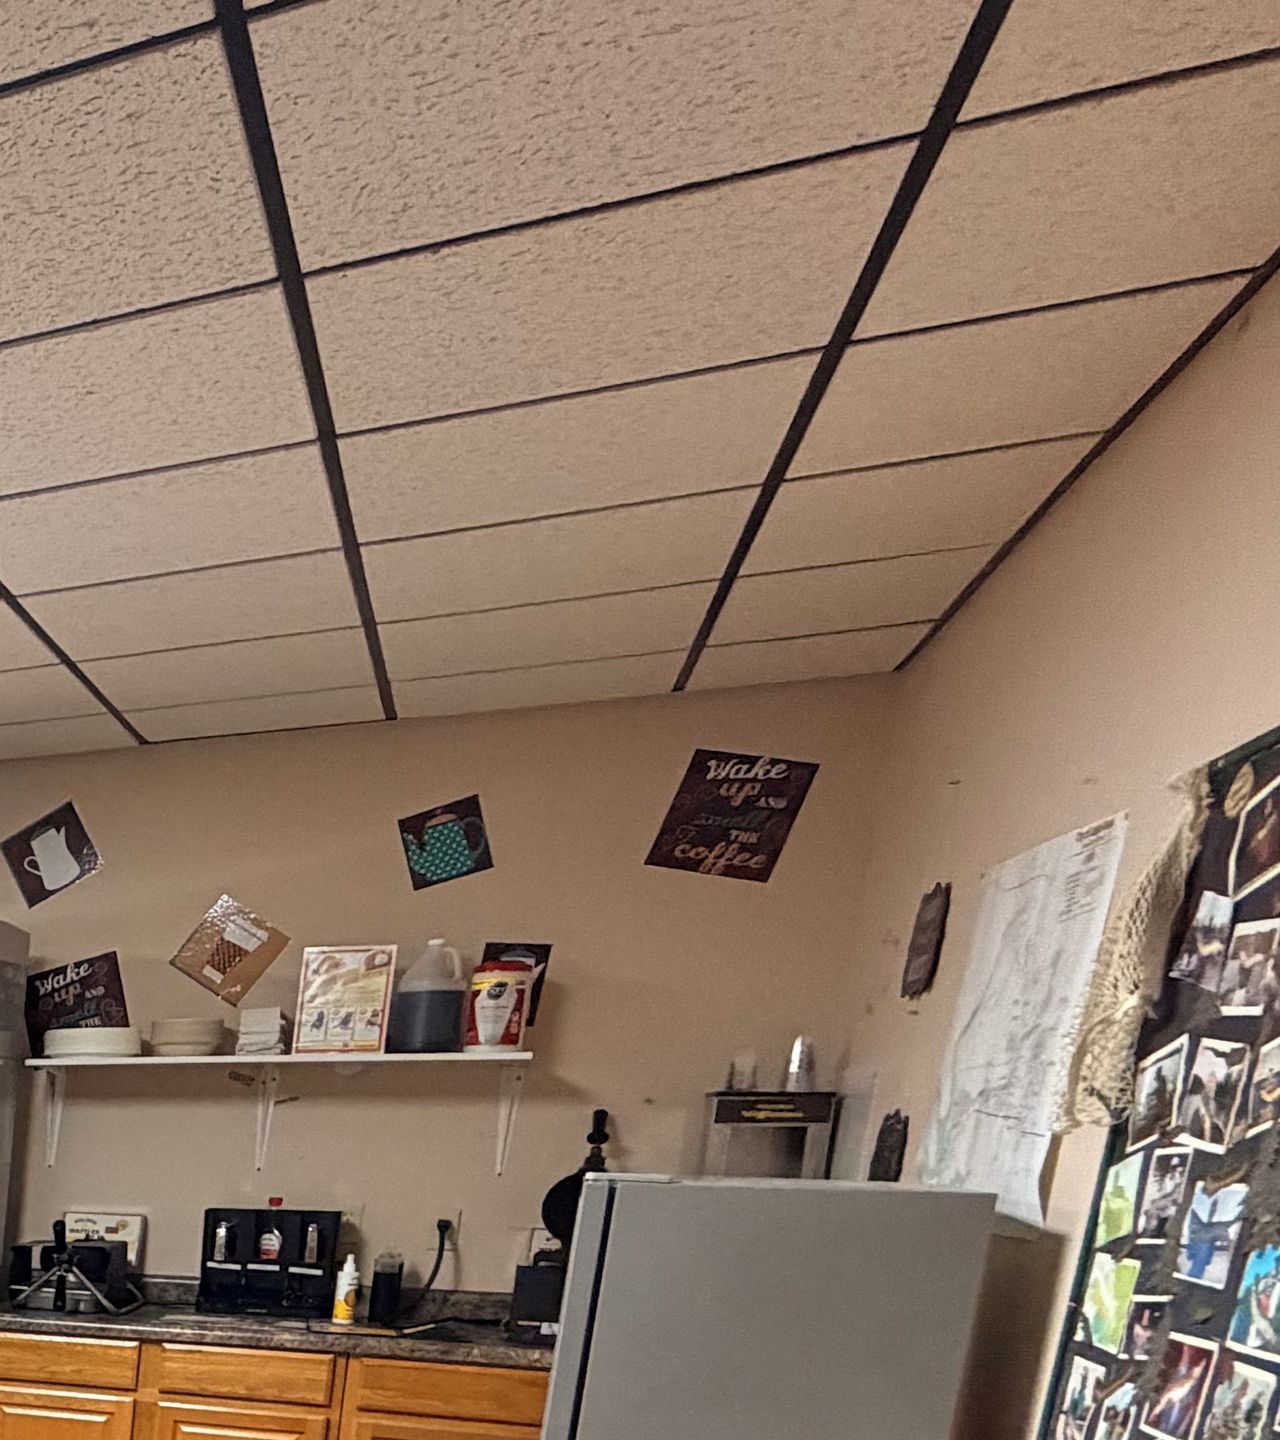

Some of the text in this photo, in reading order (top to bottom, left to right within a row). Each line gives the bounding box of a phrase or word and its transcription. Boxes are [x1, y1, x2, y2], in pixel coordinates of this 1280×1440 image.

[706, 756, 790, 780] Wake
[719, 782, 762, 807] up
[673, 841, 768, 875] coffee
[35, 963, 93, 997] Wake
[53, 982, 81, 1007] up
